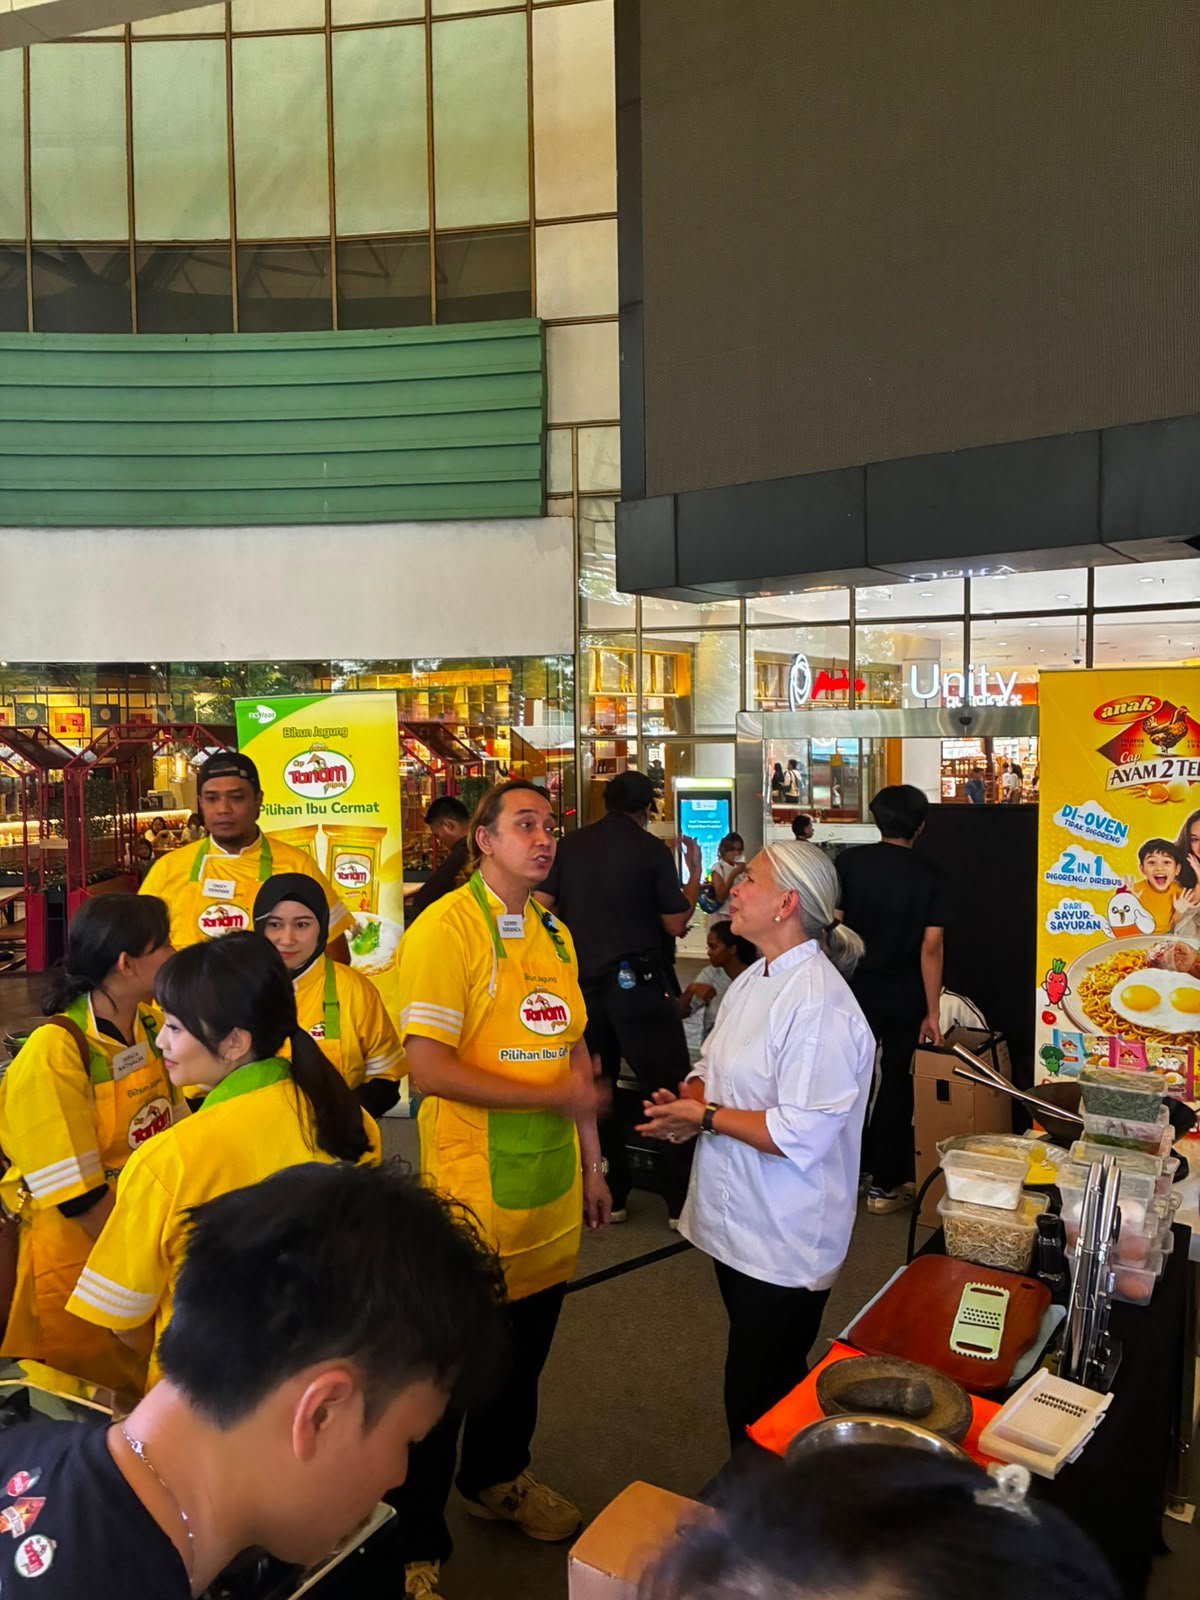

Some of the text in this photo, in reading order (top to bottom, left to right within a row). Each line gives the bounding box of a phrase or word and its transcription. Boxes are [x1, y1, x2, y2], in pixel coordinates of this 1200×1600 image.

[911, 664, 1018, 705] Unity
[1101, 698, 1156, 719] anak
[283, 726, 348, 738] Bihun Jagung
[1120, 751, 1142, 765] Cap
[288, 764, 347, 784] Tanam
[1110, 764, 1157, 786] AYAM
[1160, 760, 1174, 778] 2
[306, 803, 327, 814] Ibu
[331, 801, 380, 814] Cermat
[1061, 804, 1129, 838] DI-OVEN
[1064, 819, 1121, 844] TIDAK DIGORENG
[1061, 853, 1103, 876] 2 IN 1
[337, 871, 367, 883] Tanam
[1089, 877, 1123, 886] DIREBUS
[1063, 902, 1082, 910] DARI
[201, 914, 244, 928] Tanam
[1049, 920, 1101, 930] SAYURAN
[522, 1005, 568, 1022] Tanam
[500, 1050, 540, 1061] Pilihan
[542, 1048, 557, 1059] Ibu
